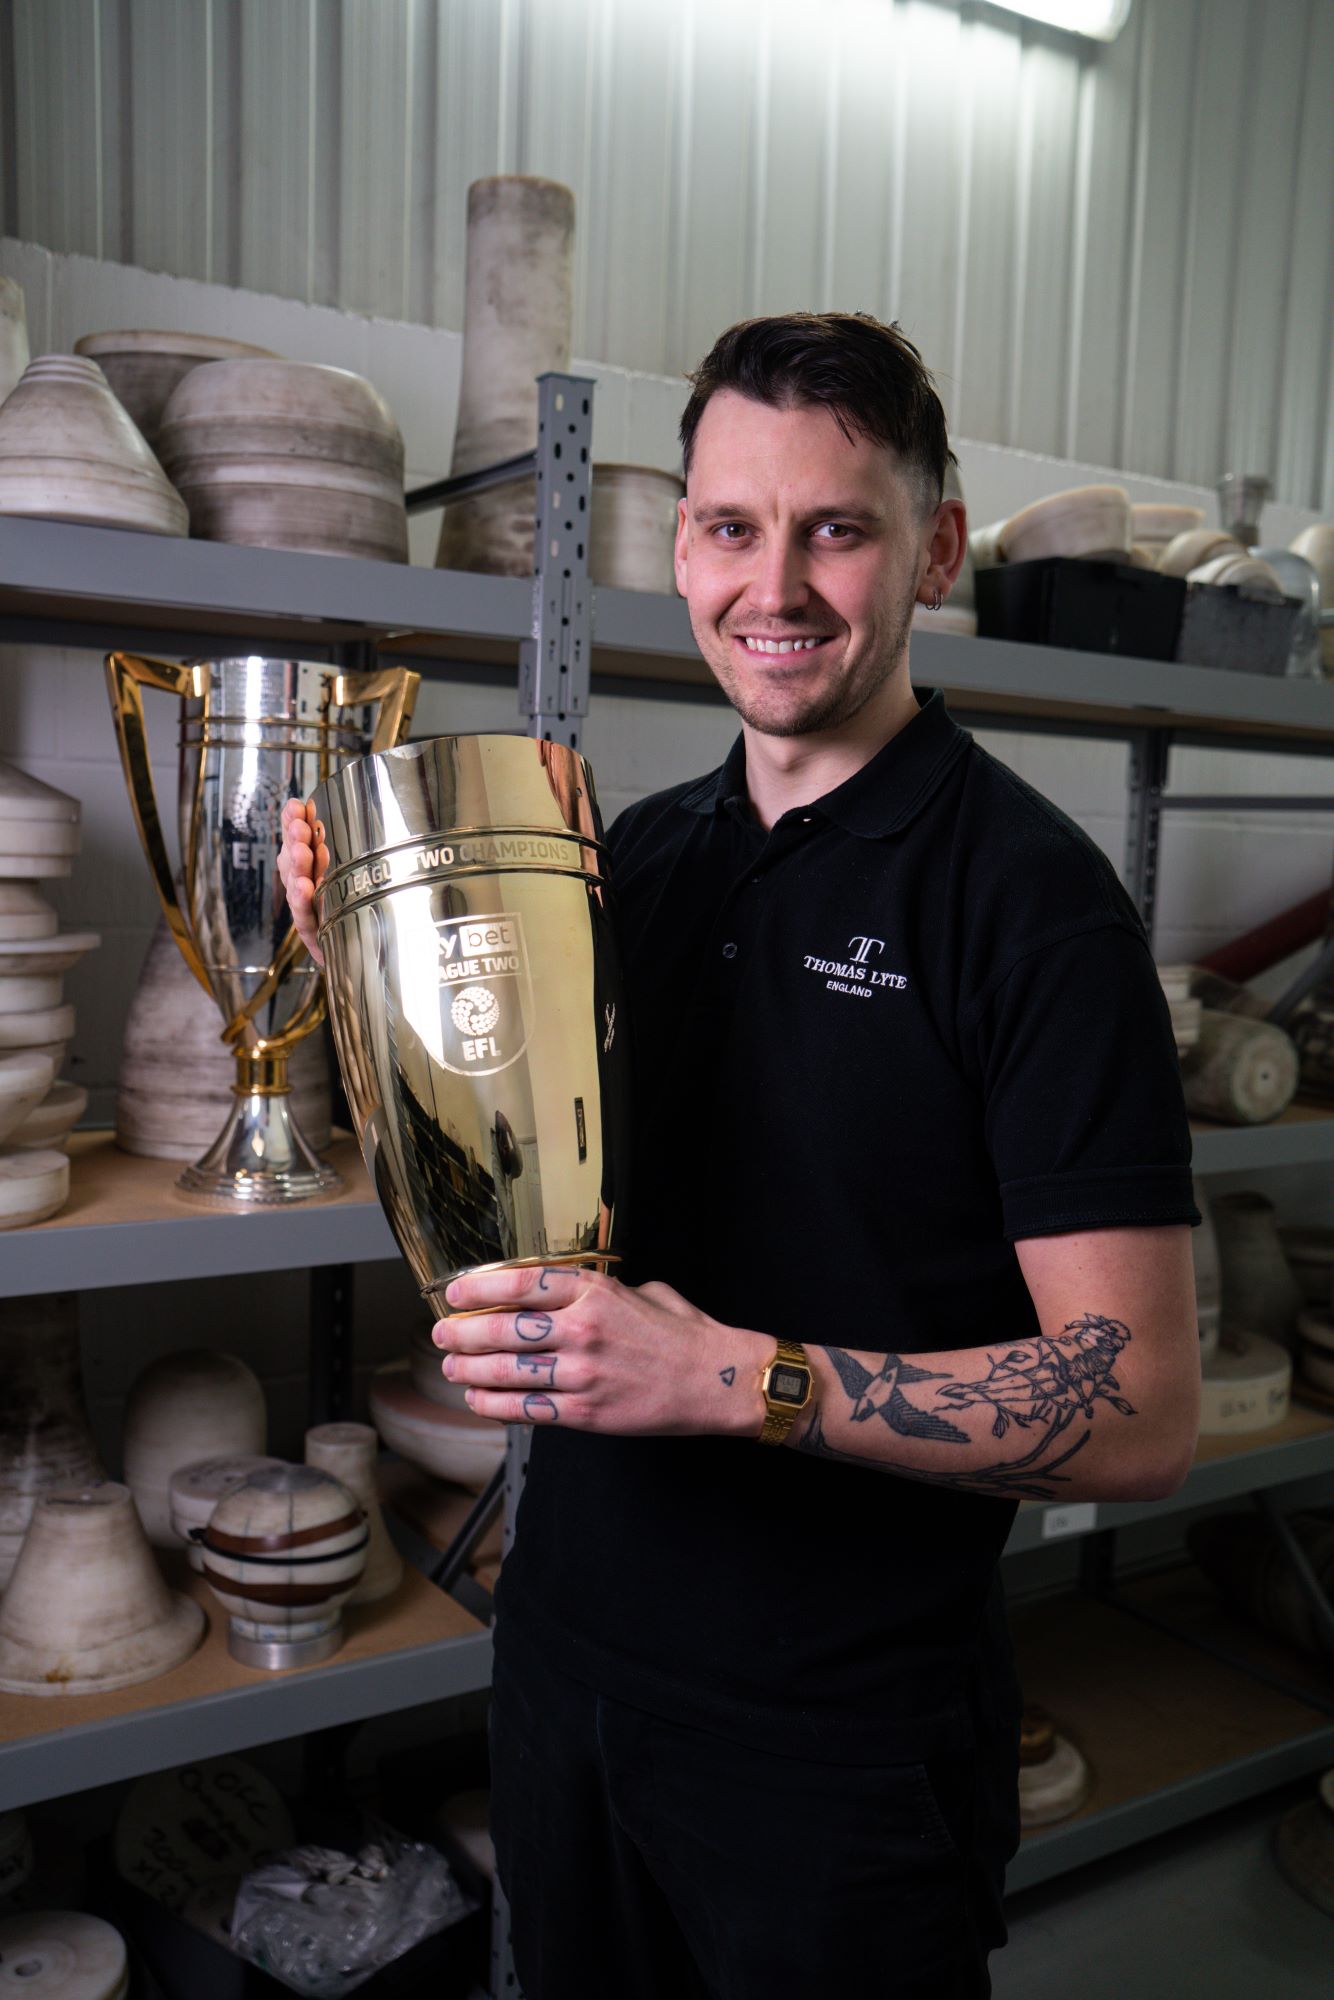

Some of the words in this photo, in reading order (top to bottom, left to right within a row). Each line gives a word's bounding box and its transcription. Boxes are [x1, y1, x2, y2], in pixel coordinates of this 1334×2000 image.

[460, 840, 569, 861] CHAMPIONS
[467, 926, 511, 948] bet
[481, 955, 520, 973] TWO
[803, 955, 866, 979] THOMAS
[869, 970, 907, 989] LYTE
[826, 980, 873, 998] ENGLAND
[462, 1036, 502, 1061] EFL
